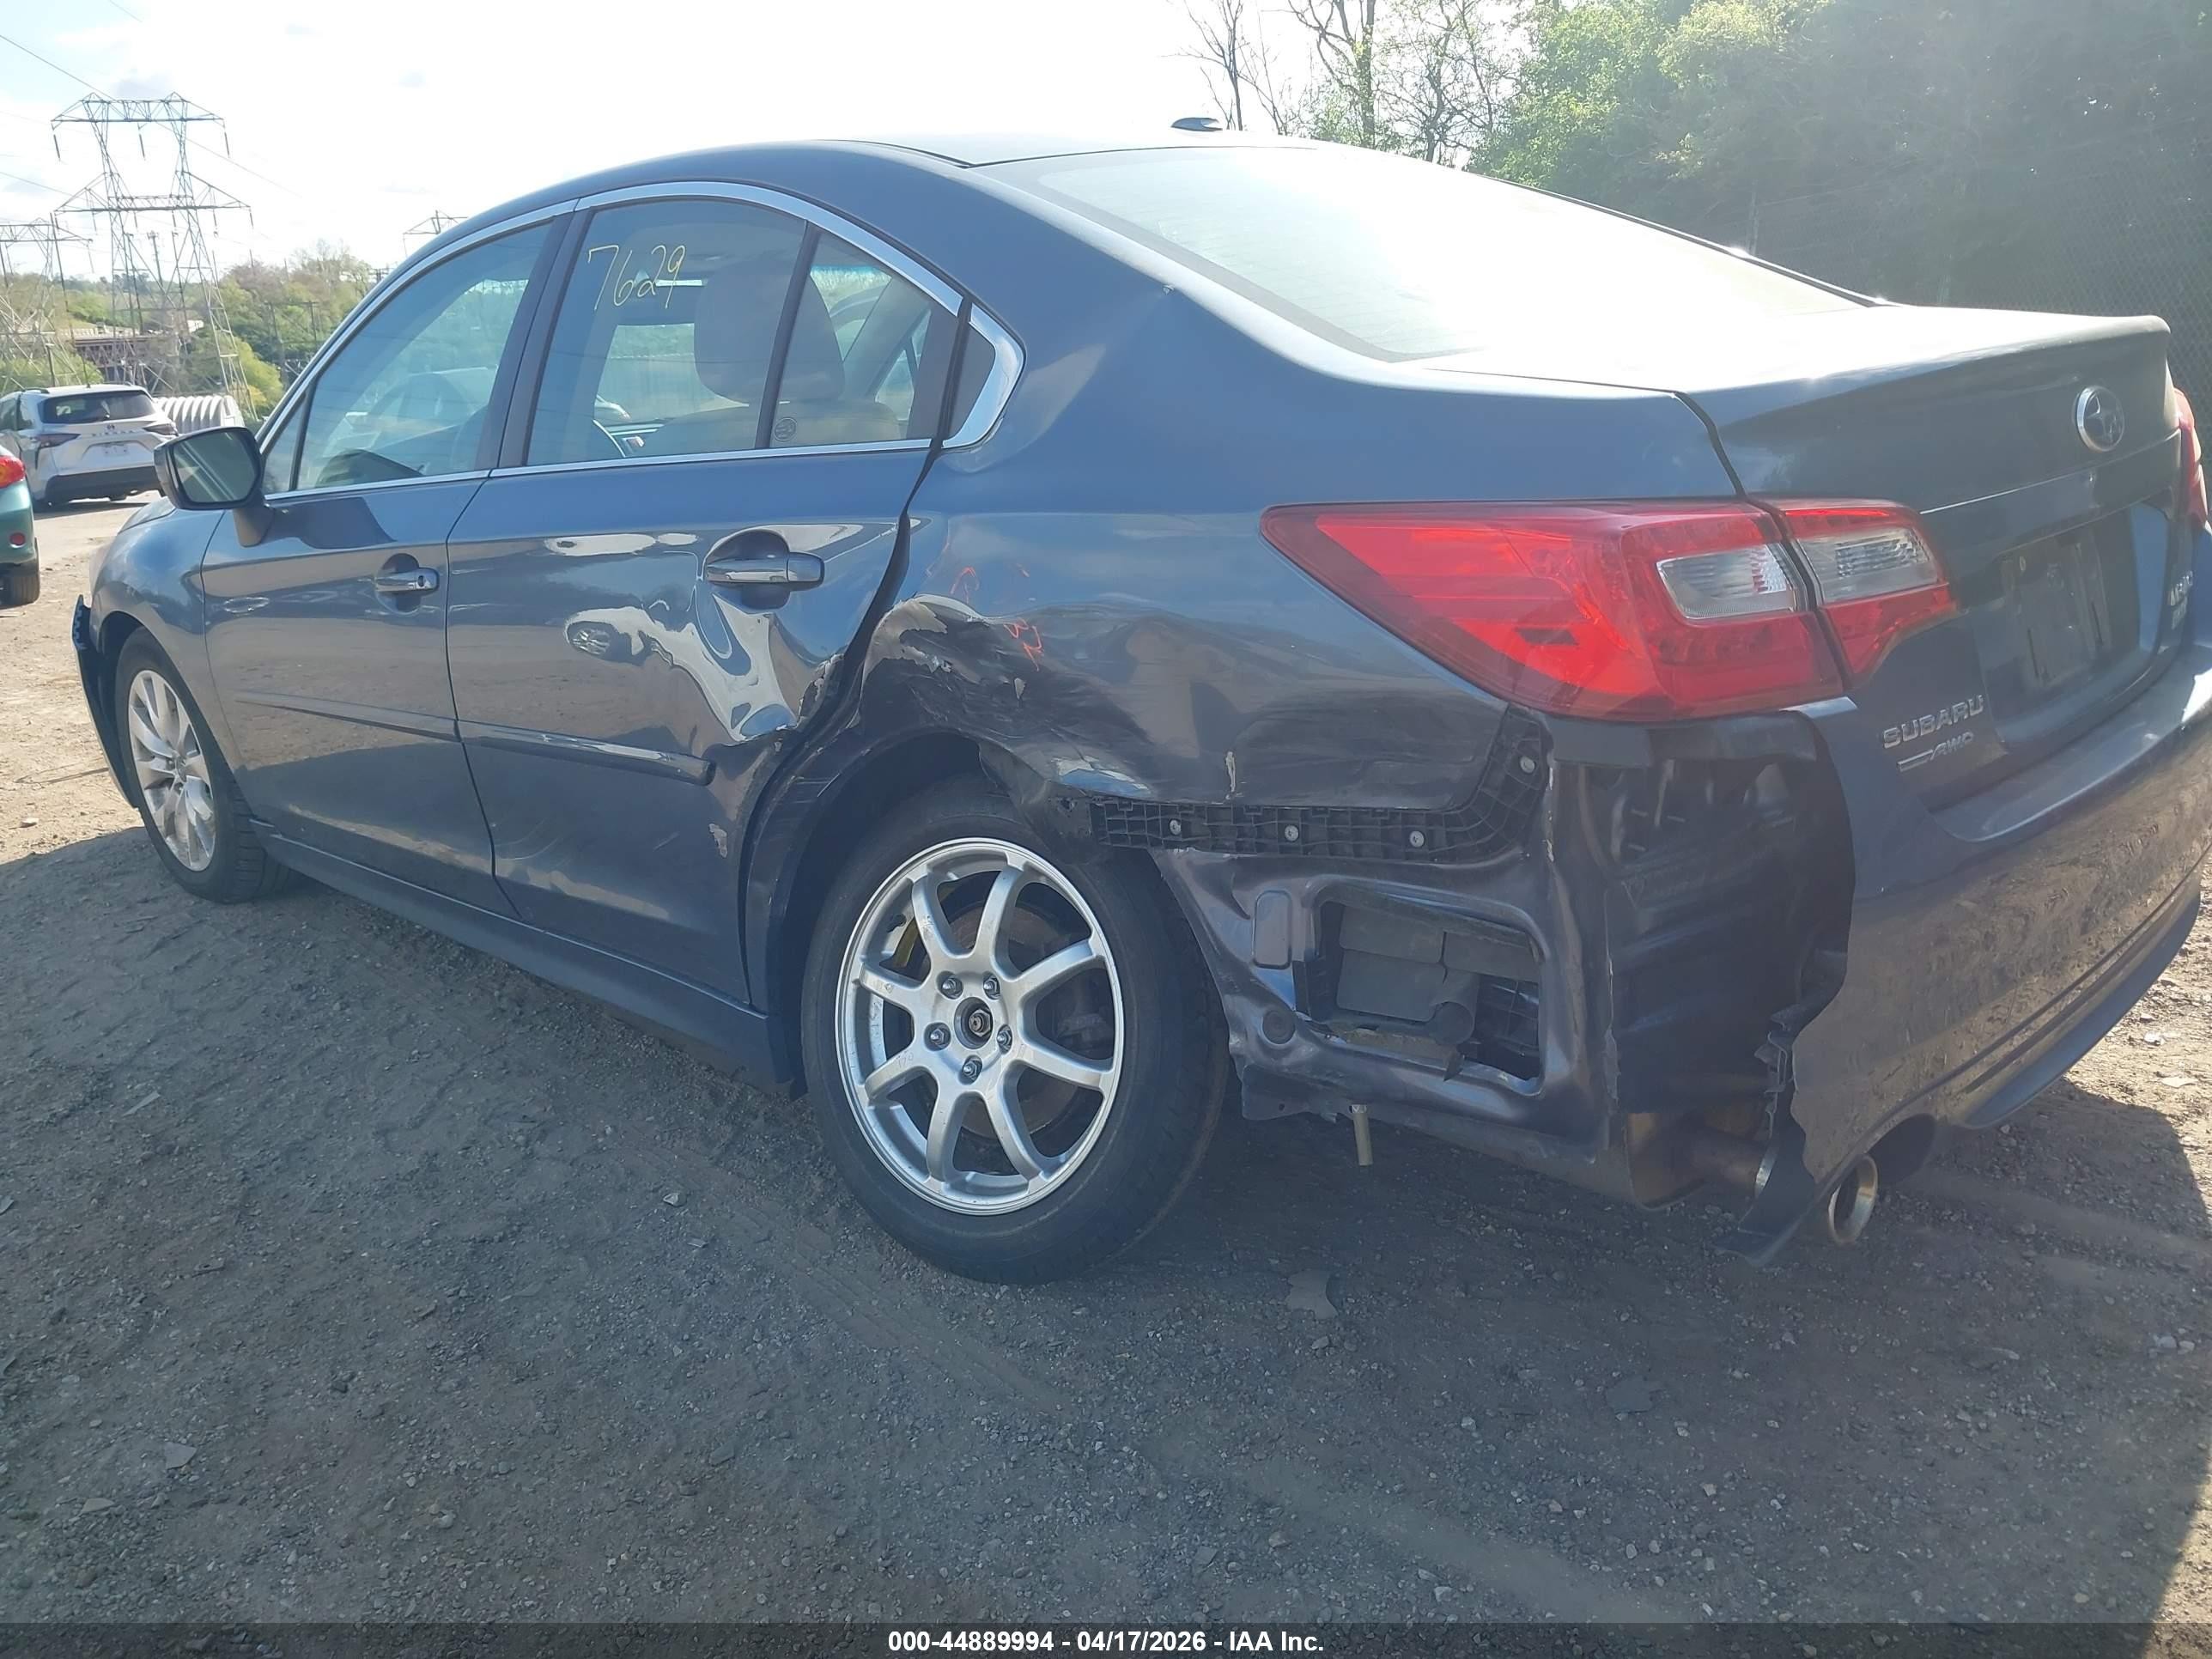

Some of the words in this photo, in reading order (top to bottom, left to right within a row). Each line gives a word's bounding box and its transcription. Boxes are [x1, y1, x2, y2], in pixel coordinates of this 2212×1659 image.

[587, 245, 686, 311] 7629
[1883, 695, 1984, 749] SUBARU
[1930, 731, 1975, 760] AWD
